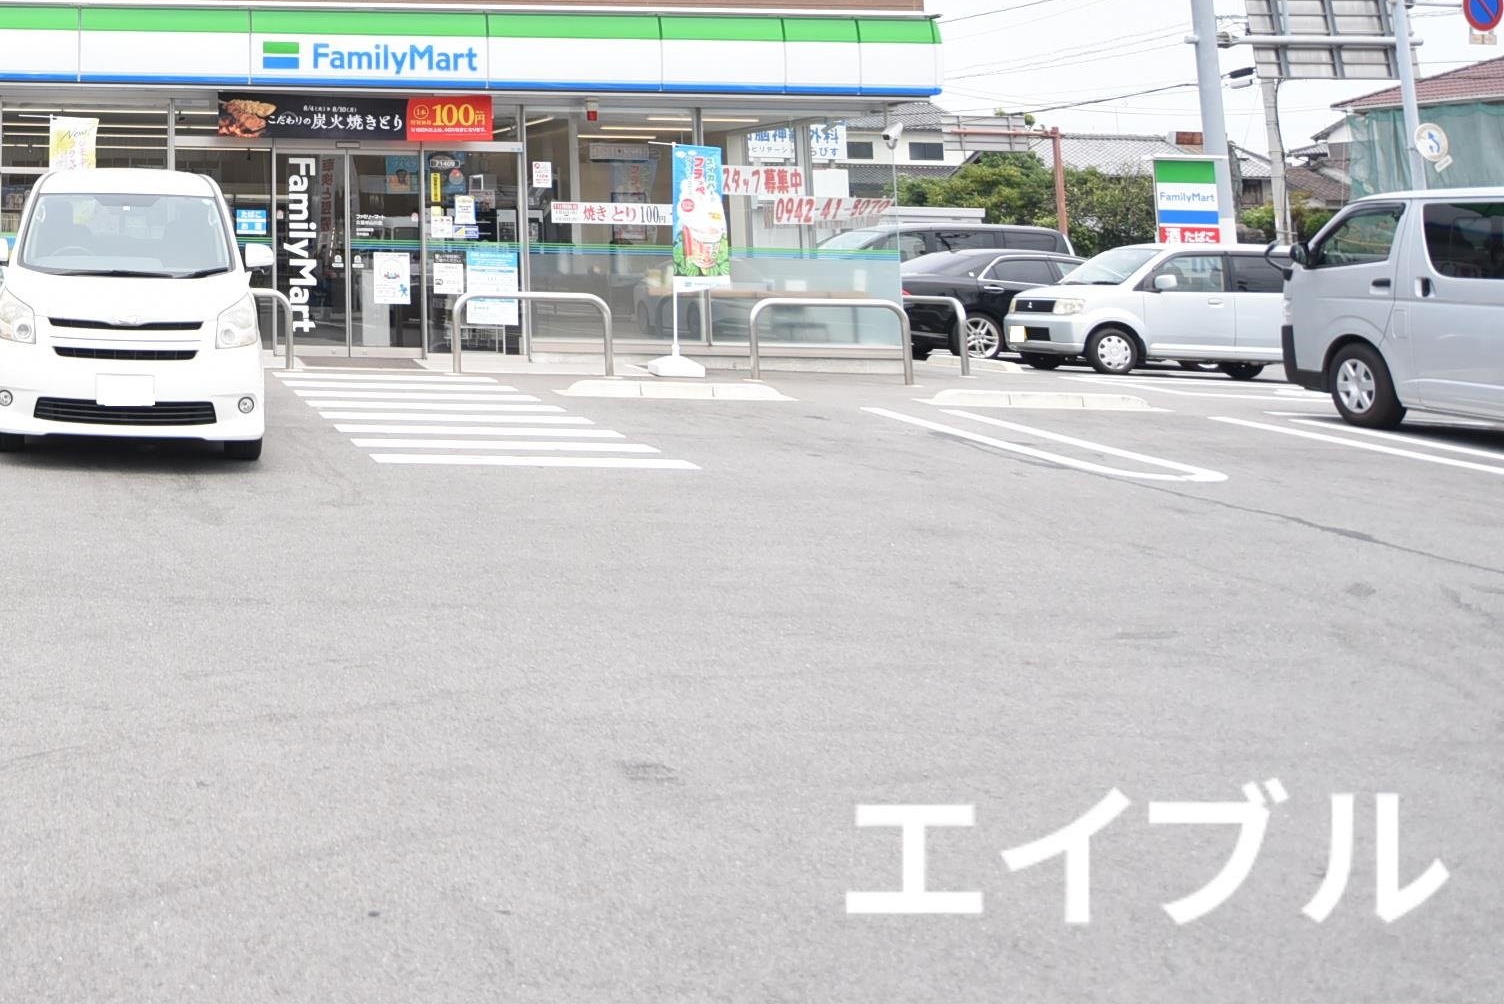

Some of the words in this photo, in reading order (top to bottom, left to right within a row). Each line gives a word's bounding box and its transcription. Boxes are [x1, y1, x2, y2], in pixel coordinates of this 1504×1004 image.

[312, 43, 478, 74] FamilyMart
[268, 113, 403, 132] こだわりの炭火焼きとり
[432, 103, 486, 126] 100円
[722, 167, 803, 194] スタッフ募集中
[1159, 192, 1215, 203] FamilyMart
[283, 157, 317, 333] FamilyMart
